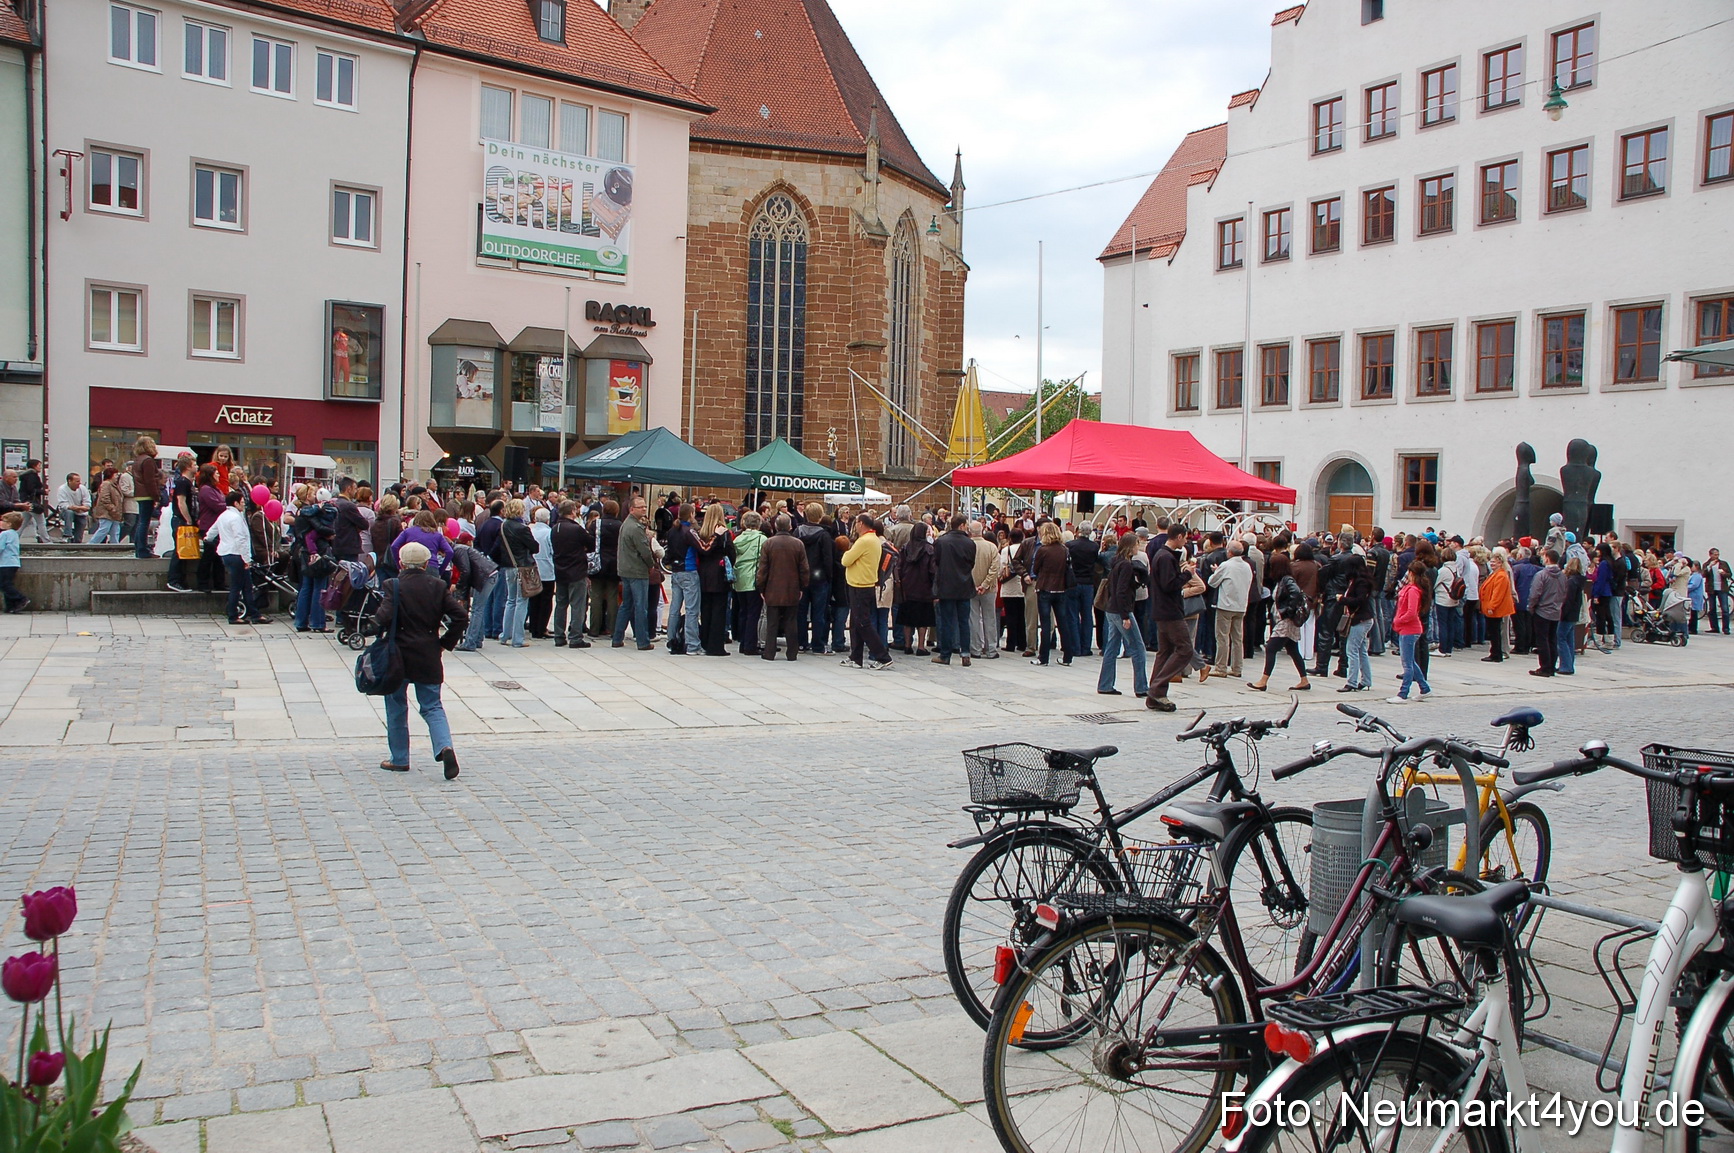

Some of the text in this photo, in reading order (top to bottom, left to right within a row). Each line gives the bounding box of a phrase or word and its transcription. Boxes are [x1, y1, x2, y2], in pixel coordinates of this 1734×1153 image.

[488, 142, 600, 174] Dein nächster
[485, 165, 601, 239] GRILL
[585, 300, 657, 327] RACKL
[593, 324, 648, 338] am Rathaus
[538, 363, 563, 378] RACKL
[214, 404, 273, 425] Achatz
[760, 475, 846, 492] OUTDOORCHEF
[1635, 1020, 1664, 1133] HERCULES
